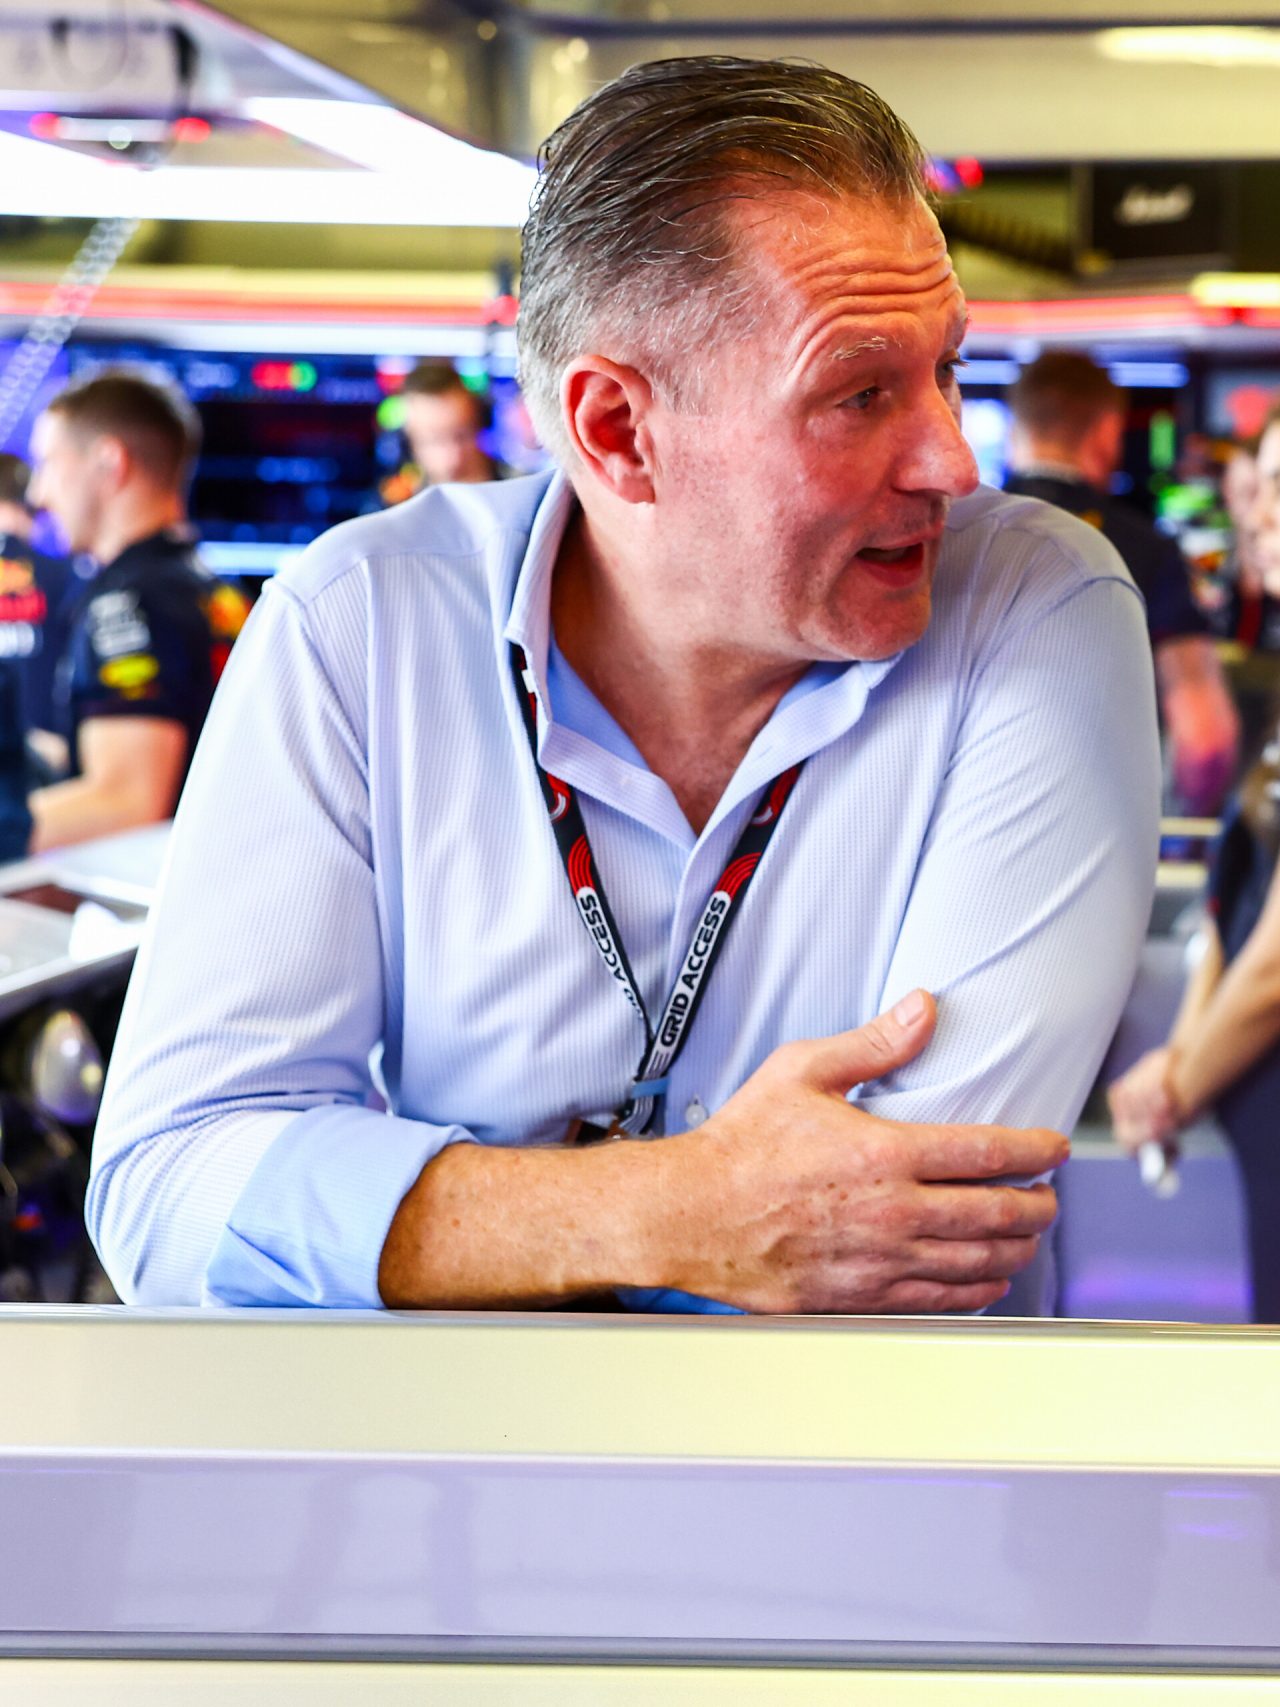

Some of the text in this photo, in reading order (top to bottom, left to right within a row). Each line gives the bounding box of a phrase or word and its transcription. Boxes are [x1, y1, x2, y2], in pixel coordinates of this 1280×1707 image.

[579, 893, 627, 983] ACCESS
[660, 896, 728, 1047] GRID ACCESS
